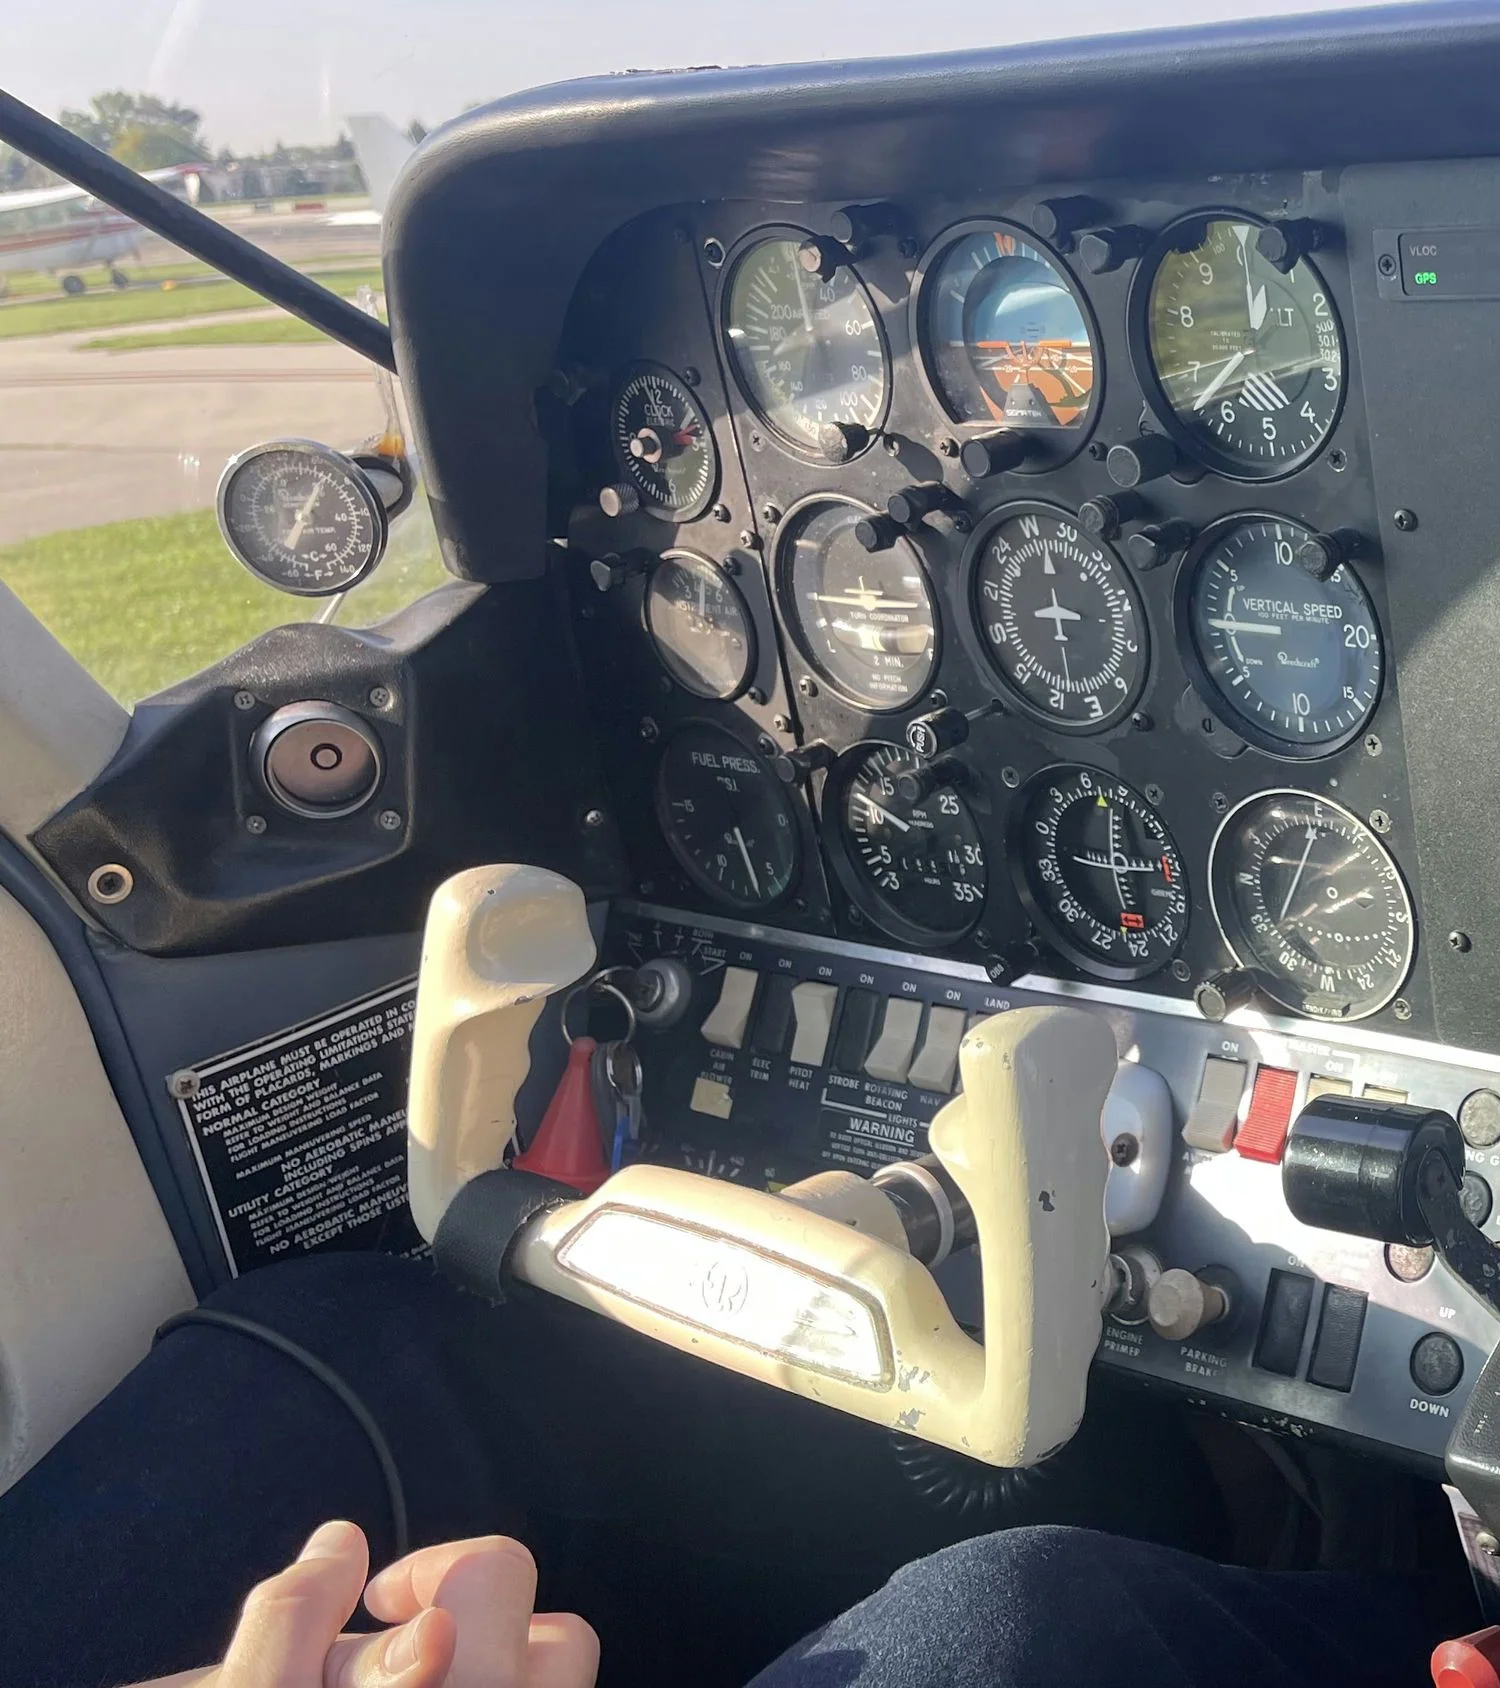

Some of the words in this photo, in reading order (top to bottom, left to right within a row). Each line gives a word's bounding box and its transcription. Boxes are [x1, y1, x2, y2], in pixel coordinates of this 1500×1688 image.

[1409, 245, 1437, 256] VLOC
[1415, 272, 1437, 284] GPS
[1274, 542, 1293, 566] 10
[1243, 598, 1299, 614] VERTICAL
[1303, 603, 1343, 619] SPEED
[1343, 624, 1369, 648] 20
[692, 752, 721, 768] FUEL
[940, 795, 960, 815] 25
[778, 959, 792, 969] ON
[818, 967, 832, 977] ON
[860, 974, 874, 985] ON
[902, 981, 916, 993] ON
[985, 997, 1010, 1010] LAND
[220, 1060, 277, 1090] AIRPLANE
[280, 1045, 310, 1067] MUST
[330, 1013, 383, 1047] OPERATED
[253, 1052, 317, 1088] OPERATING
[319, 1024, 385, 1060] LIMITATIONS
[789, 1066, 814, 1080] PITOT
[788, 1079, 811, 1092] HEAT
[828, 1074, 860, 1090] STROBE
[202, 1107, 259, 1137] NORMAL
[261, 1078, 322, 1113] CATEGORY
[865, 1096, 903, 1111] BEACON
[887, 1113, 918, 1128] LIGHTS
[849, 1117, 916, 1143] WARNING
[228, 1192, 270, 1219] UTILITY
[273, 1164, 334, 1200] CATEGORY
[1439, 1306, 1457, 1319] UP
[1180, 1346, 1228, 1368] PARKING
[1409, 1398, 1451, 1418] DOWN
